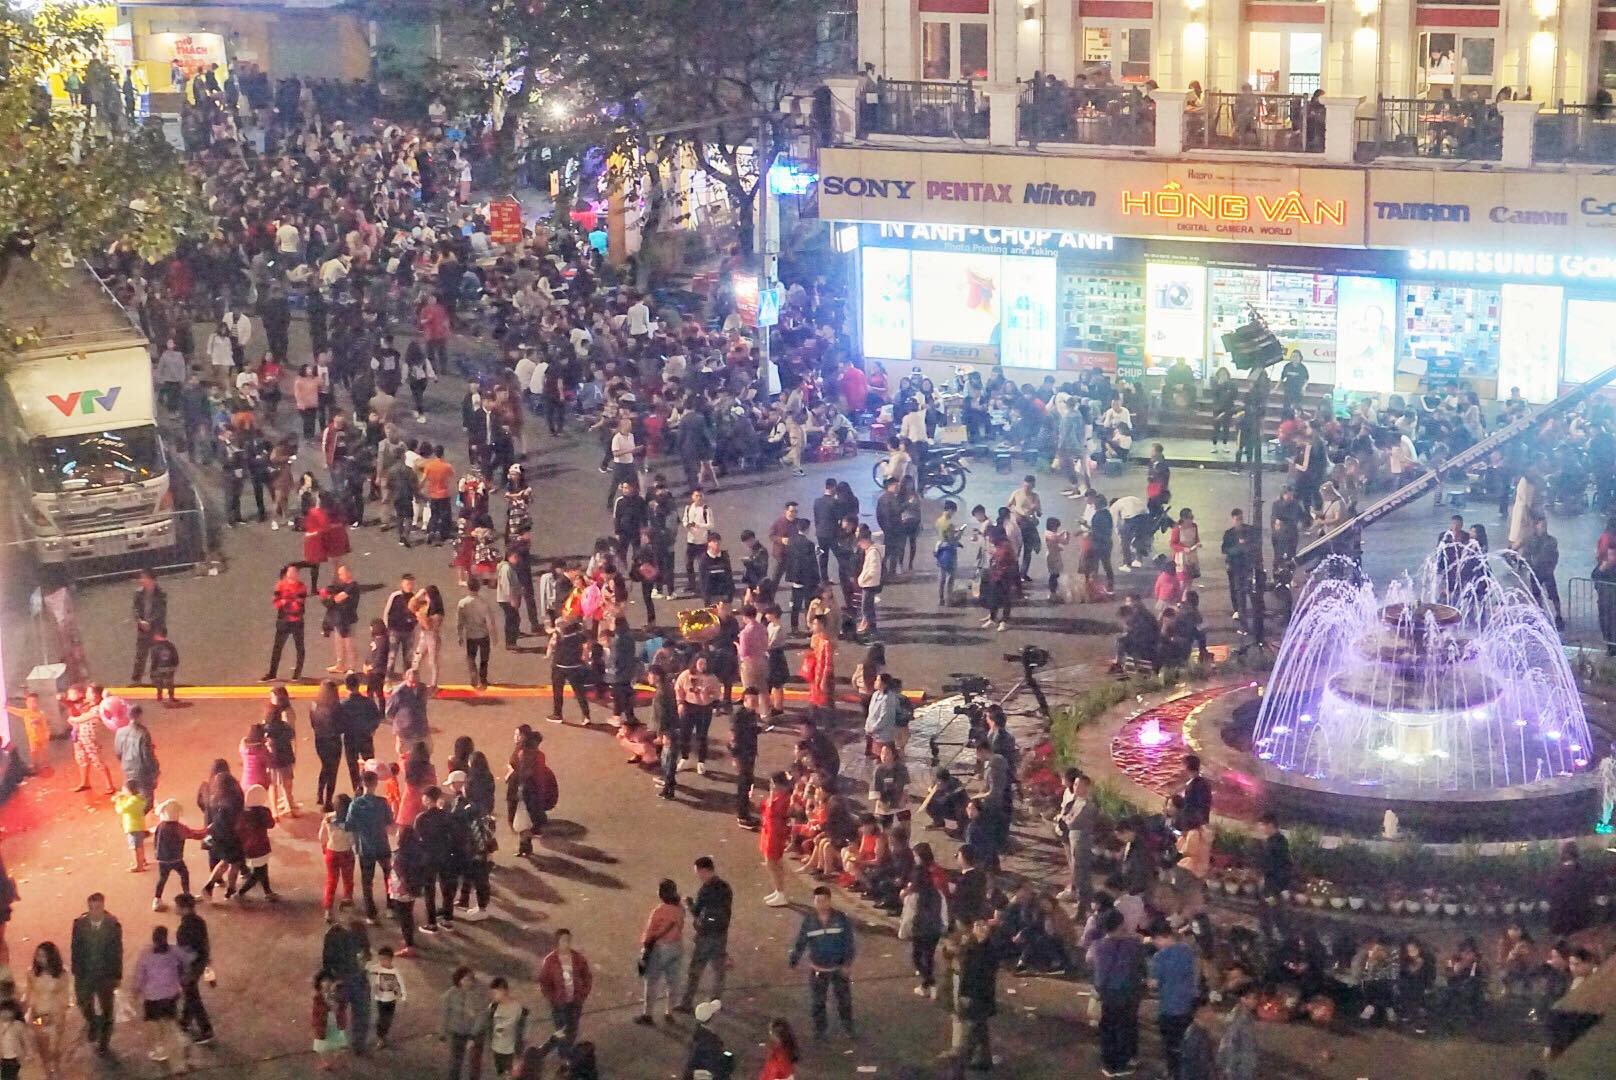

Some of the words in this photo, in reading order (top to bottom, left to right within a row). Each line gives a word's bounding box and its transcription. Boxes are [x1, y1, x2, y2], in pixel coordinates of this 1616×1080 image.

[824, 176, 915, 199] SONY
[926, 181, 1012, 203] PENTAX
[1023, 182, 1096, 207] Nikon
[1121, 181, 1249, 221] HỒNG
[1255, 191, 1346, 226] VÂN
[1373, 201, 1471, 223] TAMRON
[1489, 206, 1569, 226] Canon
[880, 222, 904, 239] IN
[1177, 223, 1209, 232] DIGITAL
[1216, 224, 1254, 234] CAMERA
[1260, 225, 1292, 235] WORLD
[944, 240, 970, 251] Photo
[972, 243, 1008, 255] Printing
[1010, 246, 1028, 255] and
[1030, 247, 1059, 257] Taking
[1408, 249, 1554, 275] SAMSUNG
[47, 387, 122, 417] VTV
